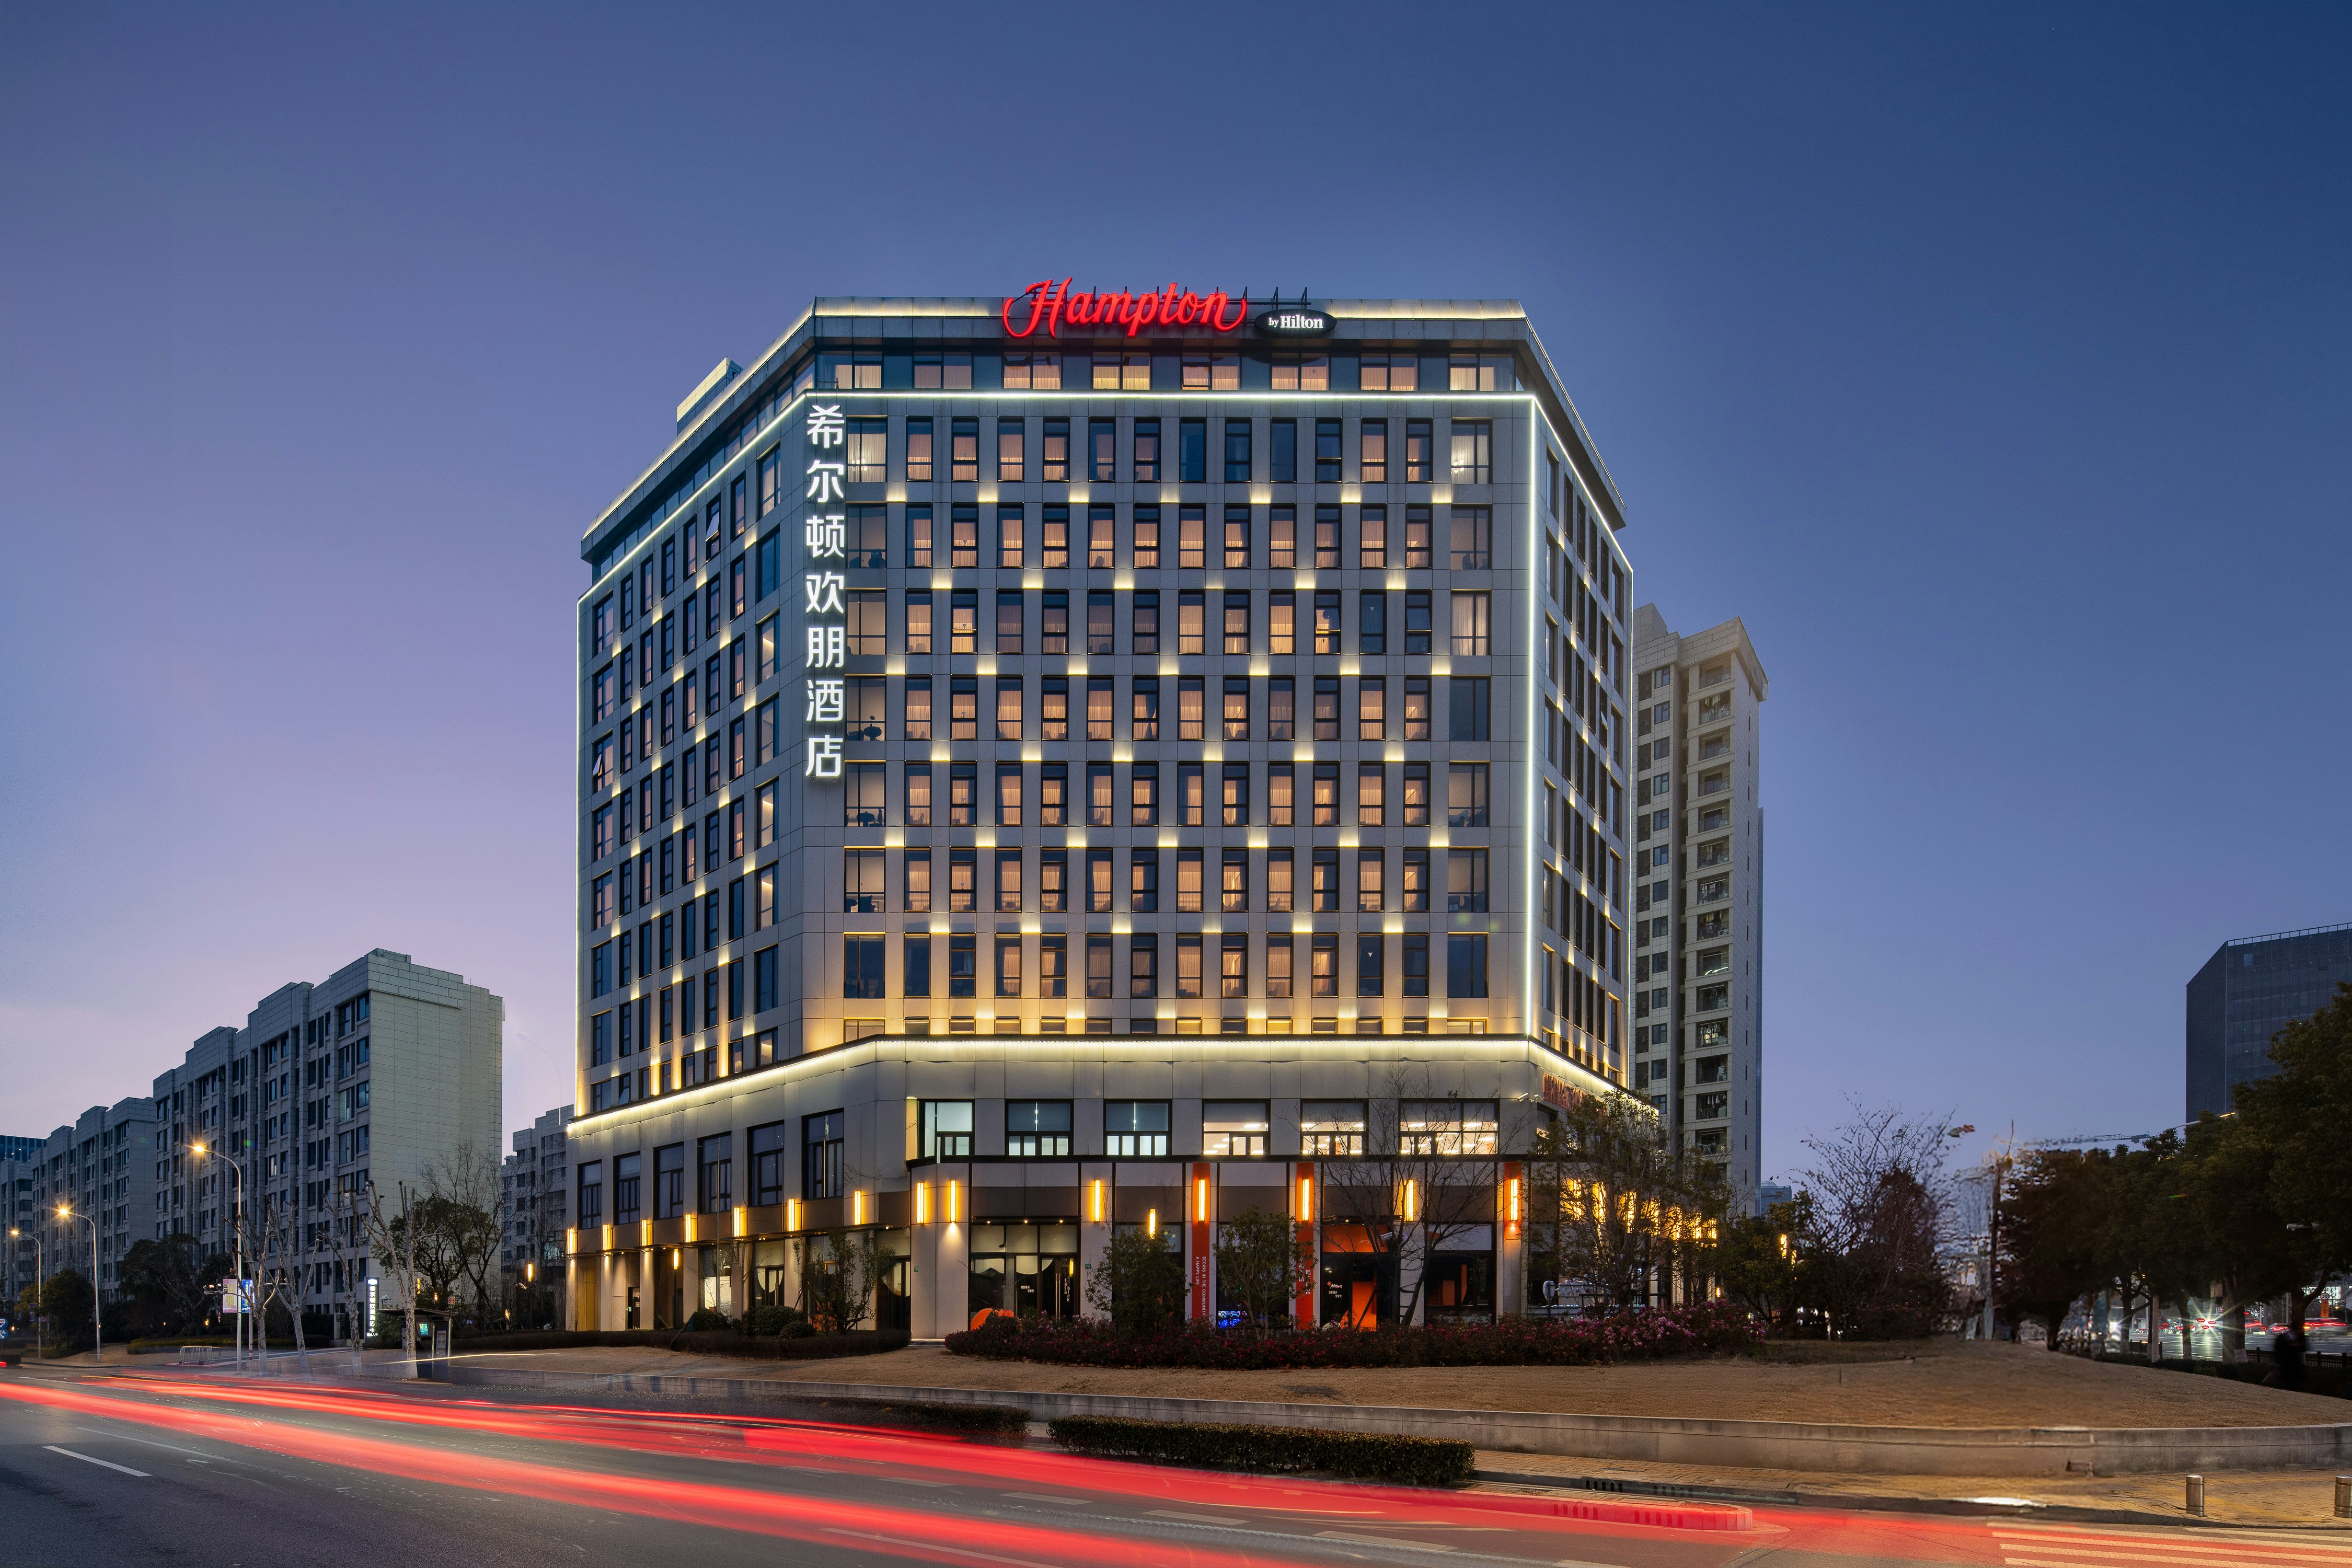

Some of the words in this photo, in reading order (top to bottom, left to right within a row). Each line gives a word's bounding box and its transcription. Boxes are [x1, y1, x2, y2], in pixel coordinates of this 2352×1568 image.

[1003, 277, 1247, 339] Hampton
[1269, 317, 1279, 328] by
[1281, 316, 1324, 329] Hilton
[806, 405, 845, 778] 希尔顿欢朋酒店
